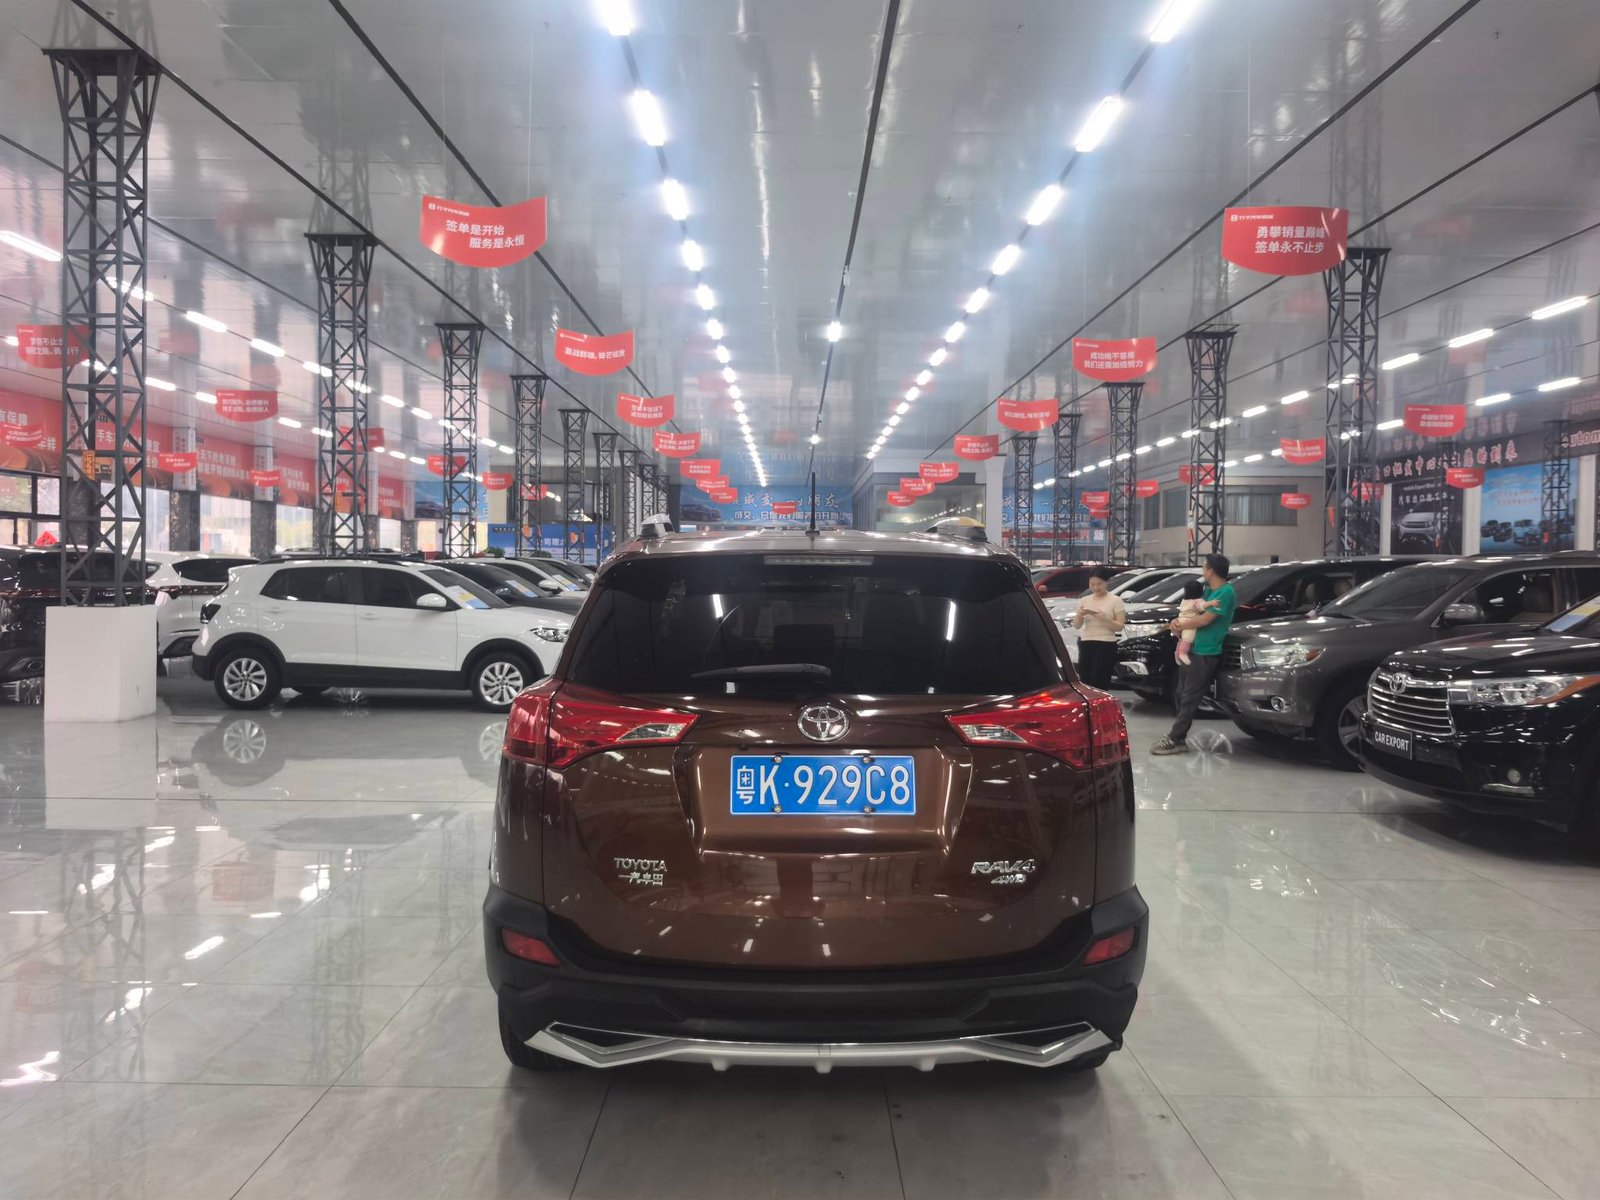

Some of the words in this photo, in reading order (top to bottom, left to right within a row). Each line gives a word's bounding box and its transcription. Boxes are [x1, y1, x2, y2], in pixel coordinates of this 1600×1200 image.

[445, 219, 505, 236] 签单是开始
[1256, 226, 1326, 239] 勇攀销量巅峰
[469, 234, 525, 249] 服务是永恒
[1255, 241, 1325, 254] 签单永不止步
[1374, 731, 1386, 745] CAR
[1386, 734, 1409, 751] EXPORT
[614, 857, 668, 872] TOYOTA
[970, 858, 1036, 875] RAV4
[618, 871, 664, 886] 一汽丰田
